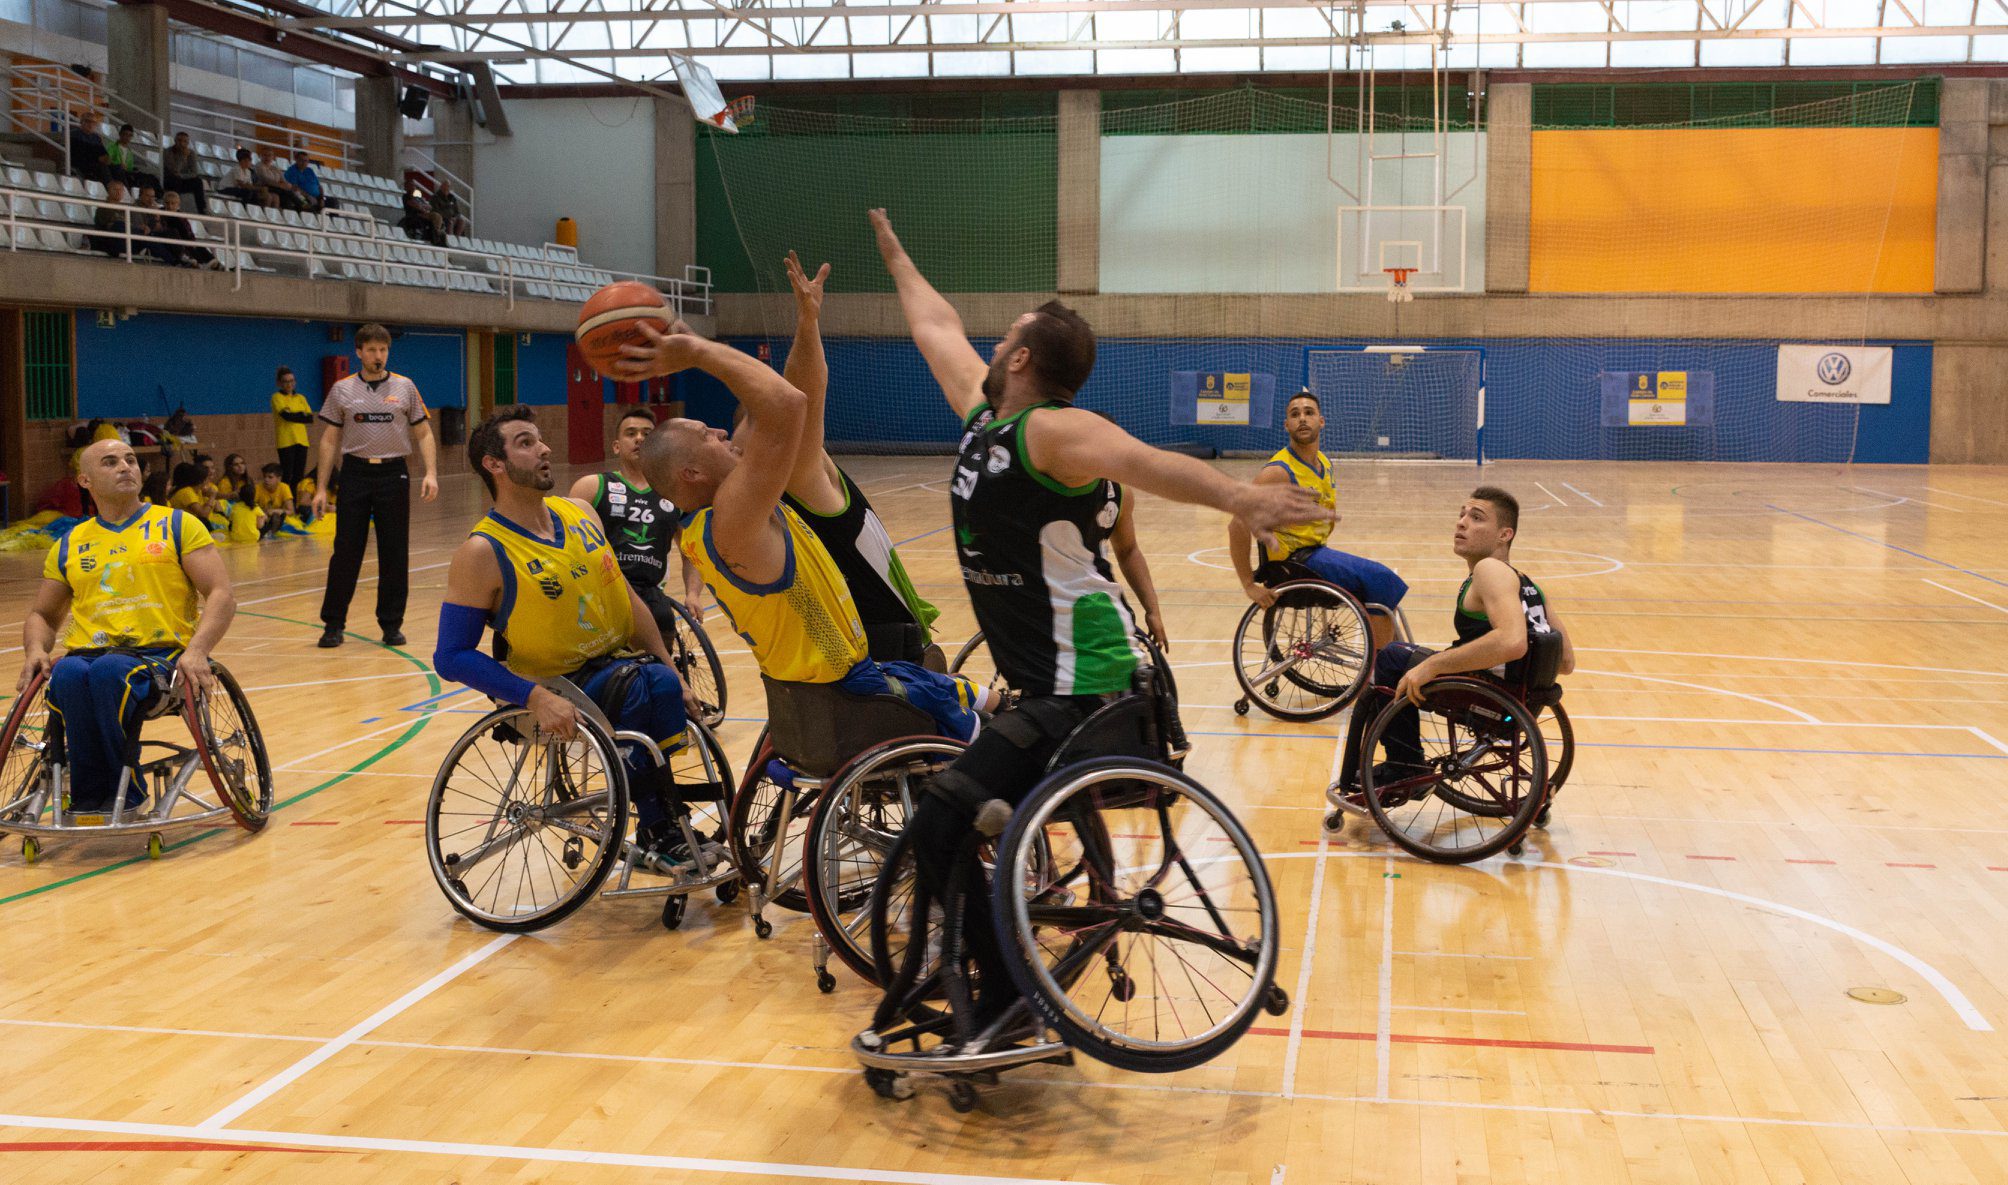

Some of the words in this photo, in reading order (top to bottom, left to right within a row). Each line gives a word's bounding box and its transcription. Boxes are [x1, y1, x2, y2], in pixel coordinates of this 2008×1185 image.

[1808, 389, 1857, 398] Comerciales
[628, 507, 655, 524] 26
[139, 516, 168, 540] 11
[569, 518, 606, 553] 20
[618, 552, 662, 568] tremadura
[571, 564, 588, 579] KS
